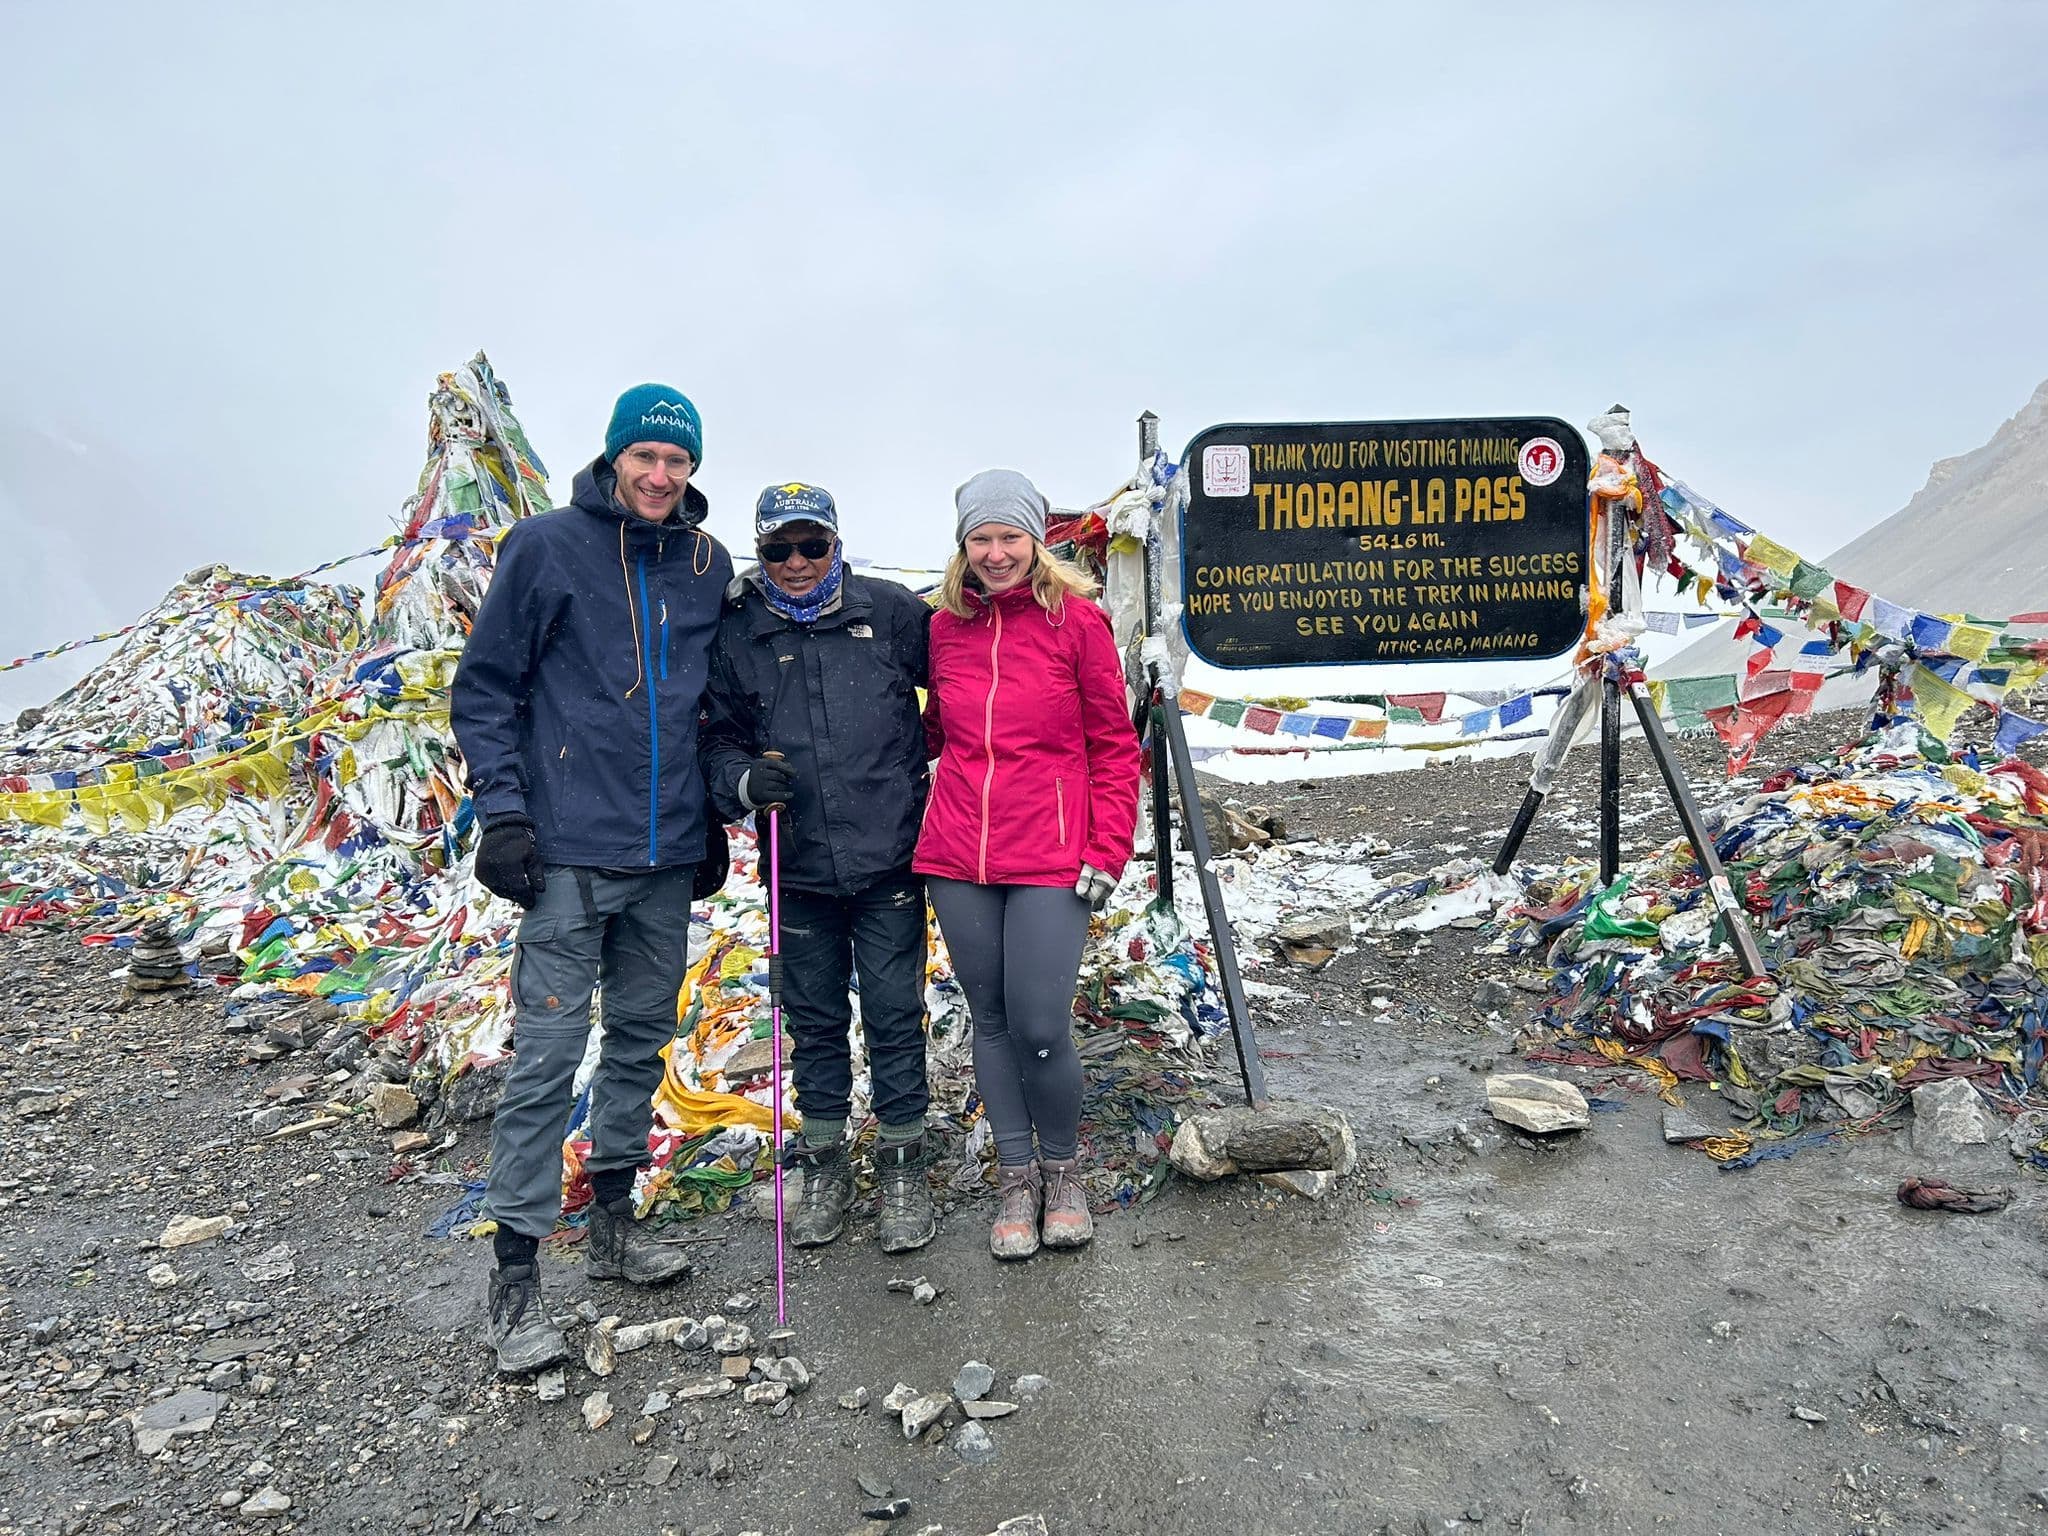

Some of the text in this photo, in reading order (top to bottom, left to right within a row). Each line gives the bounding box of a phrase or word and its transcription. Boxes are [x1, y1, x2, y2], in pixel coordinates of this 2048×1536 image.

[641, 415, 695, 433] MANANG
[1251, 442, 1307, 472] THANK
[1311, 442, 1343, 470] YOU
[1349, 439, 1378, 469] FOR
[1383, 438, 1456, 468] VISITING
[1461, 437, 1519, 466] MANANG
[774, 498, 820, 510] AUSTRALIA
[1253, 475, 1526, 531] THORANG-LA PASS
[1359, 532, 1445, 552] 5416 m.
[1196, 551, 1579, 588] CONGRATULATION FOR THE SUCCESS
[1190, 579, 1574, 616] HOPE YOU ENJOYED THE TREK IN MANANG
[1296, 609, 1479, 637] SEE YOU AGAIN
[1470, 633, 1540, 650] MANANG
